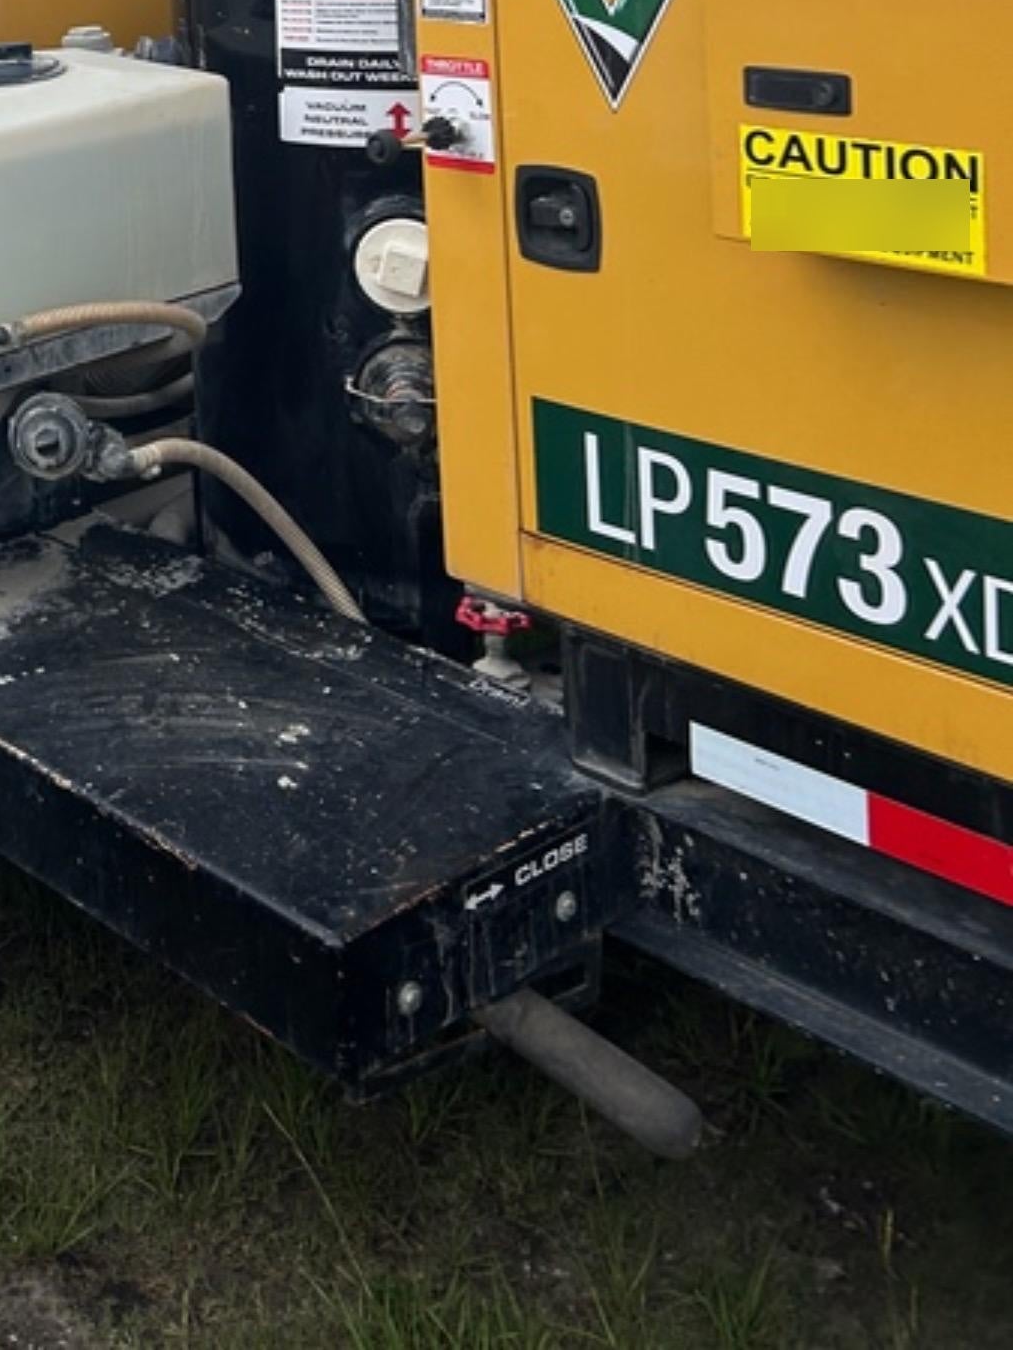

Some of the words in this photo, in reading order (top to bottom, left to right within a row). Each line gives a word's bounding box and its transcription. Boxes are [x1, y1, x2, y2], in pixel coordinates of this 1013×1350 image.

[306, 56, 354, 68] DRAIN
[425, 60, 485, 76] THROTTLE
[284, 68, 327, 80] WASH
[331, 70, 363, 82] OUT
[305, 101, 367, 112] VACUUM
[304, 114, 369, 126] NEUTRAL
[743, 129, 979, 193] CAUTION
[514, 833, 588, 886] CLOSE
